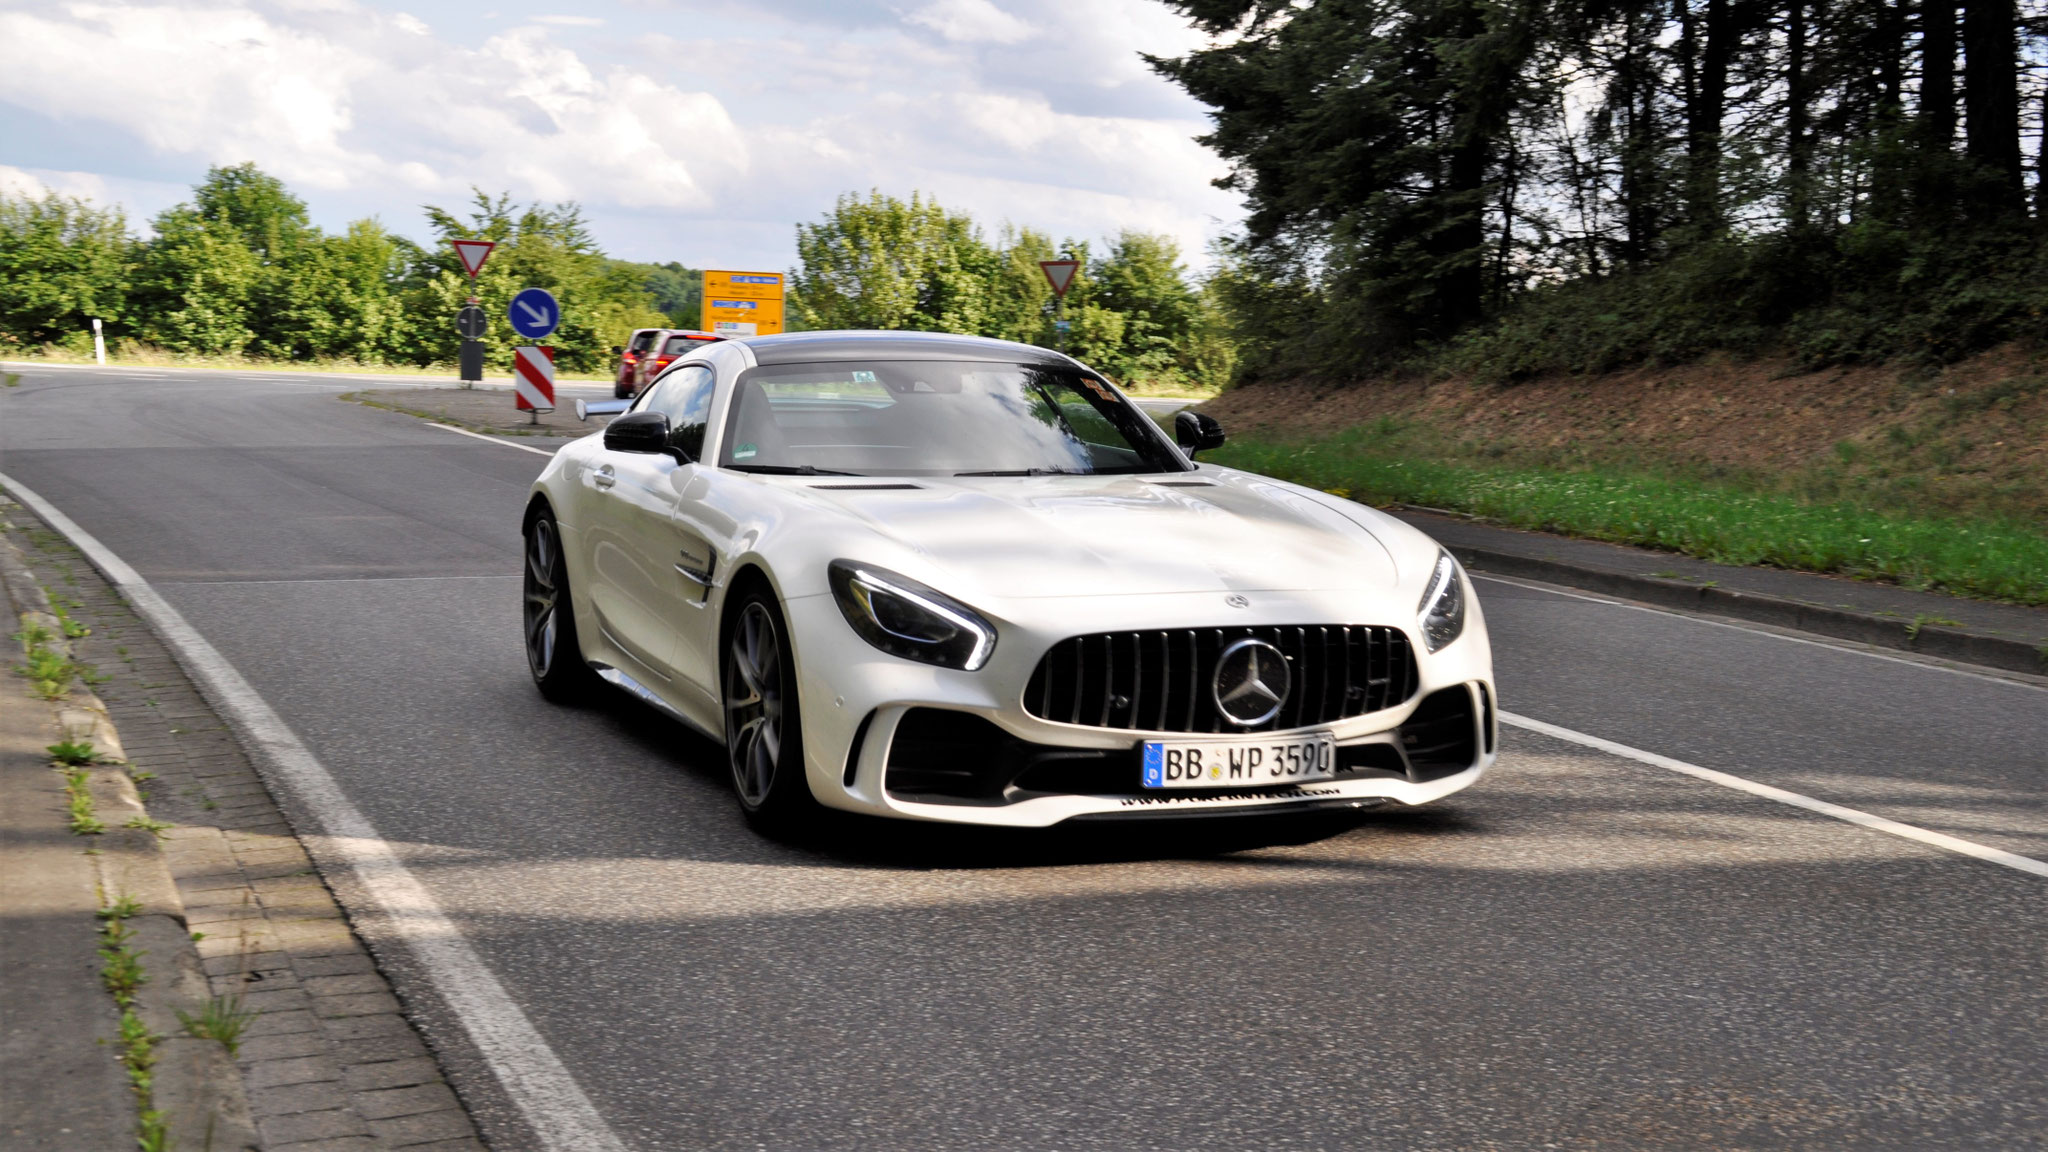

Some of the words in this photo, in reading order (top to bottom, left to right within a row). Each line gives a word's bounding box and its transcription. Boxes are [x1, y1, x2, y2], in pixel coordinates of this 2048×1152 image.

[1166, 749, 1203, 781] BB
[1229, 747, 1263, 779] WP
[1271, 742, 1329, 777] 3590
[1149, 769, 1158, 780] D
